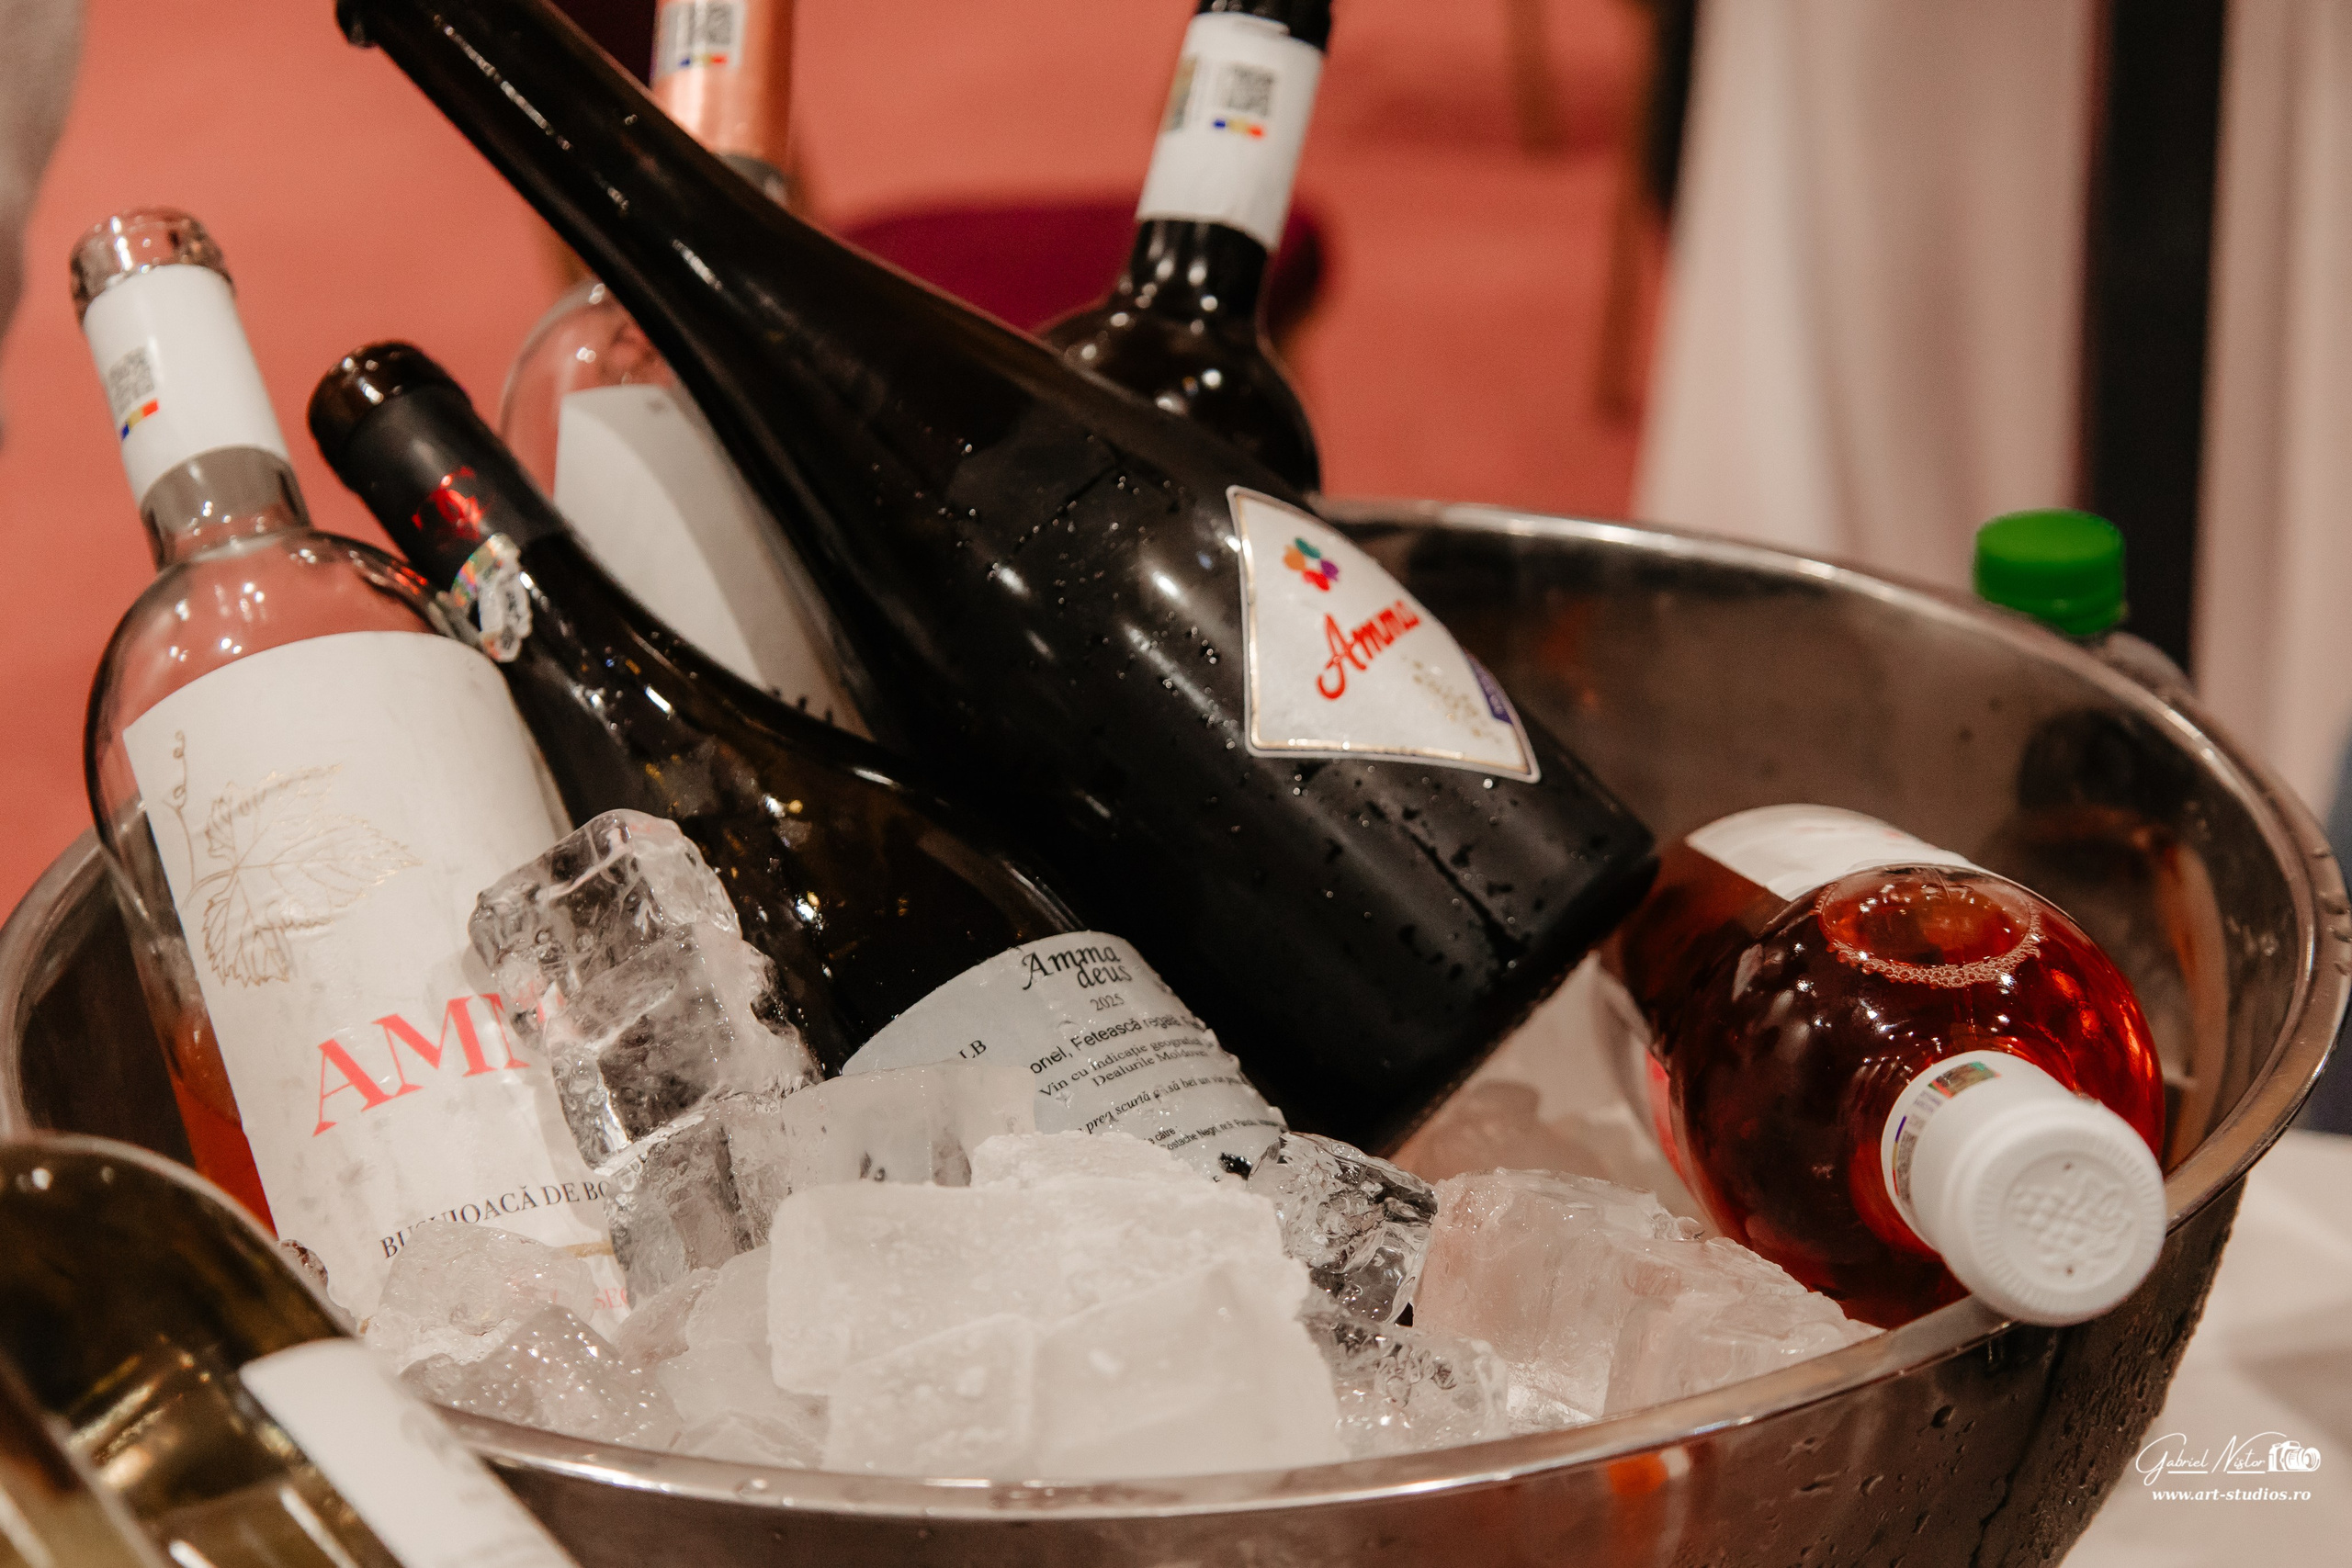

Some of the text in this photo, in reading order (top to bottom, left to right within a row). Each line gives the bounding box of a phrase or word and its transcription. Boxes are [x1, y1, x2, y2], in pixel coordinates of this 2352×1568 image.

[1021, 946, 1121, 990] Amma
[1077, 960, 1132, 988] deus
[1090, 993, 1125, 1011] 2025
[1070, 1018, 1142, 1051] Fetească
[1038, 1078, 1069, 1097] Vin
[1070, 1068, 1090, 1081] cu
[1091, 1057, 1155, 1087] Dealurile
[1159, 1134, 1198, 1150] ostache
[541, 1182, 581, 1205] DE
